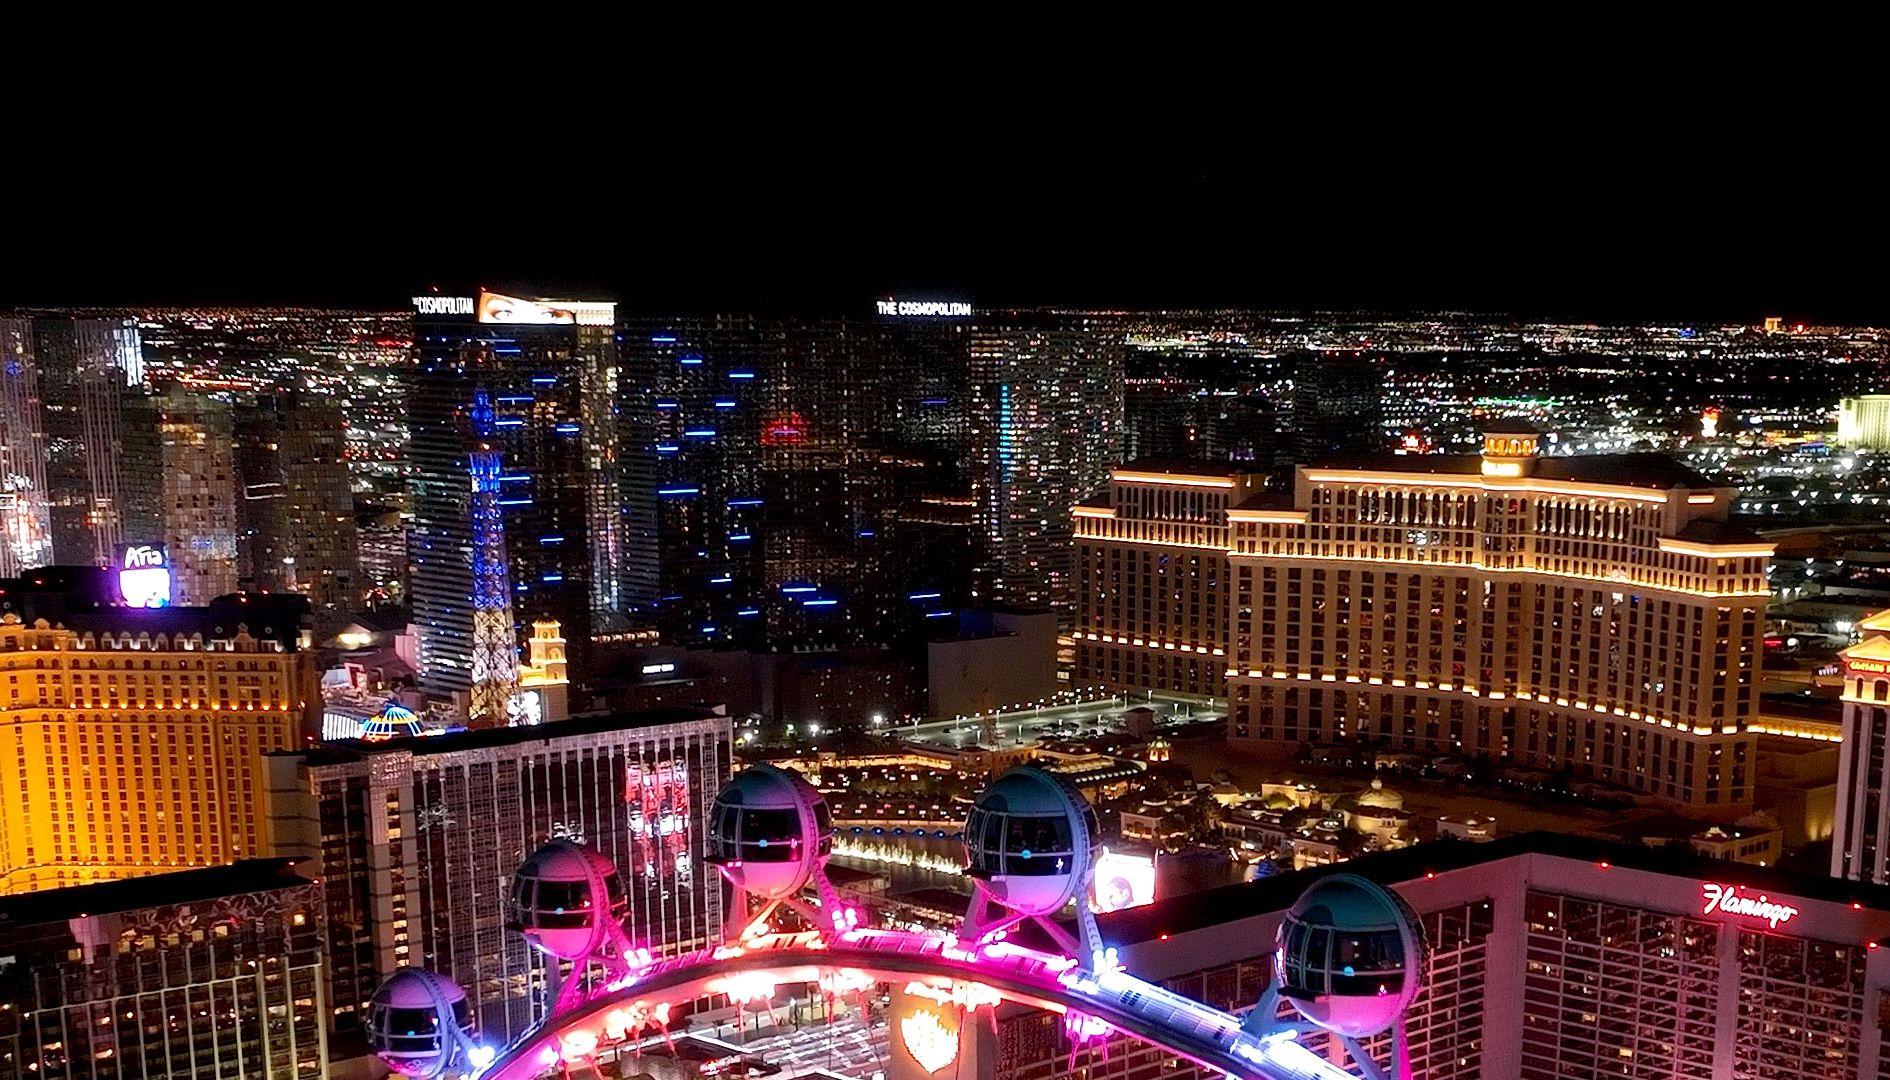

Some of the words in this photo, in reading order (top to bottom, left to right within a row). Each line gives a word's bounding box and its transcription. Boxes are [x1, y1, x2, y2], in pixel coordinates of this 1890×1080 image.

[418, 297, 474, 314] COSMOPOLITAN
[877, 301, 897, 315] THE
[898, 302, 971, 316] COSMOPOLITAN
[1702, 883, 1798, 929] Flamingo
